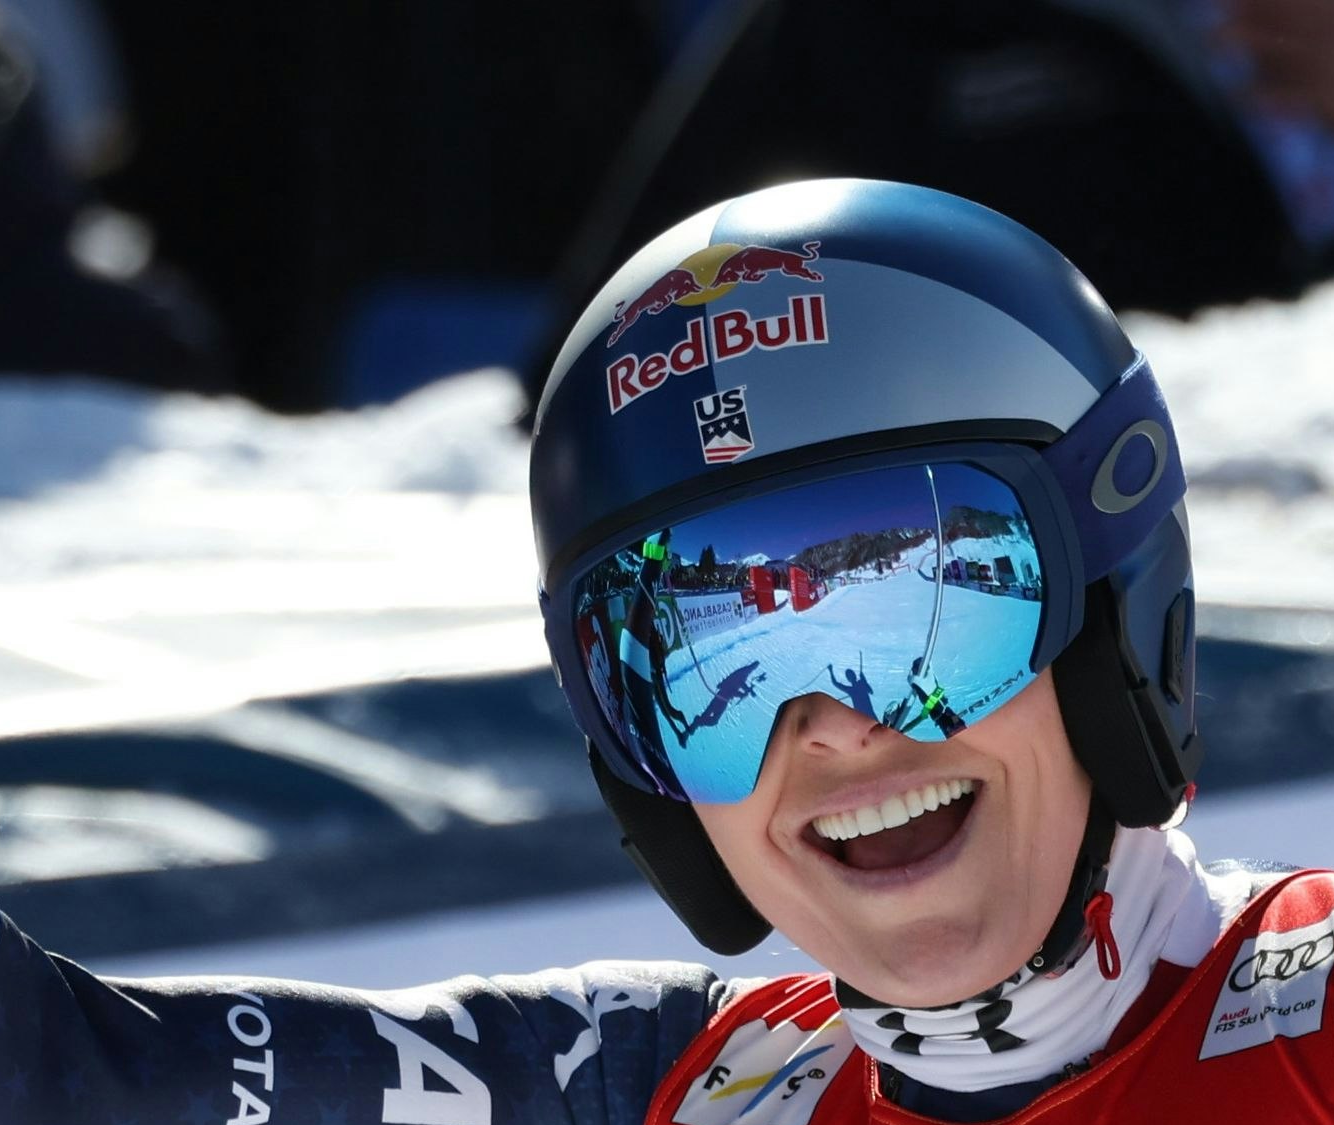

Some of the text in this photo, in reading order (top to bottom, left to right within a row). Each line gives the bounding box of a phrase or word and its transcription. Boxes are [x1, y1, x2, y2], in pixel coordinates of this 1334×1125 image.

[608, 295, 828, 413] Red Bull
[696, 388, 744, 422] US
[1214, 1020, 1236, 1034] FIS
[1293, 999, 1316, 1012] Cup
[1218, 1007, 1250, 1023] Audi
